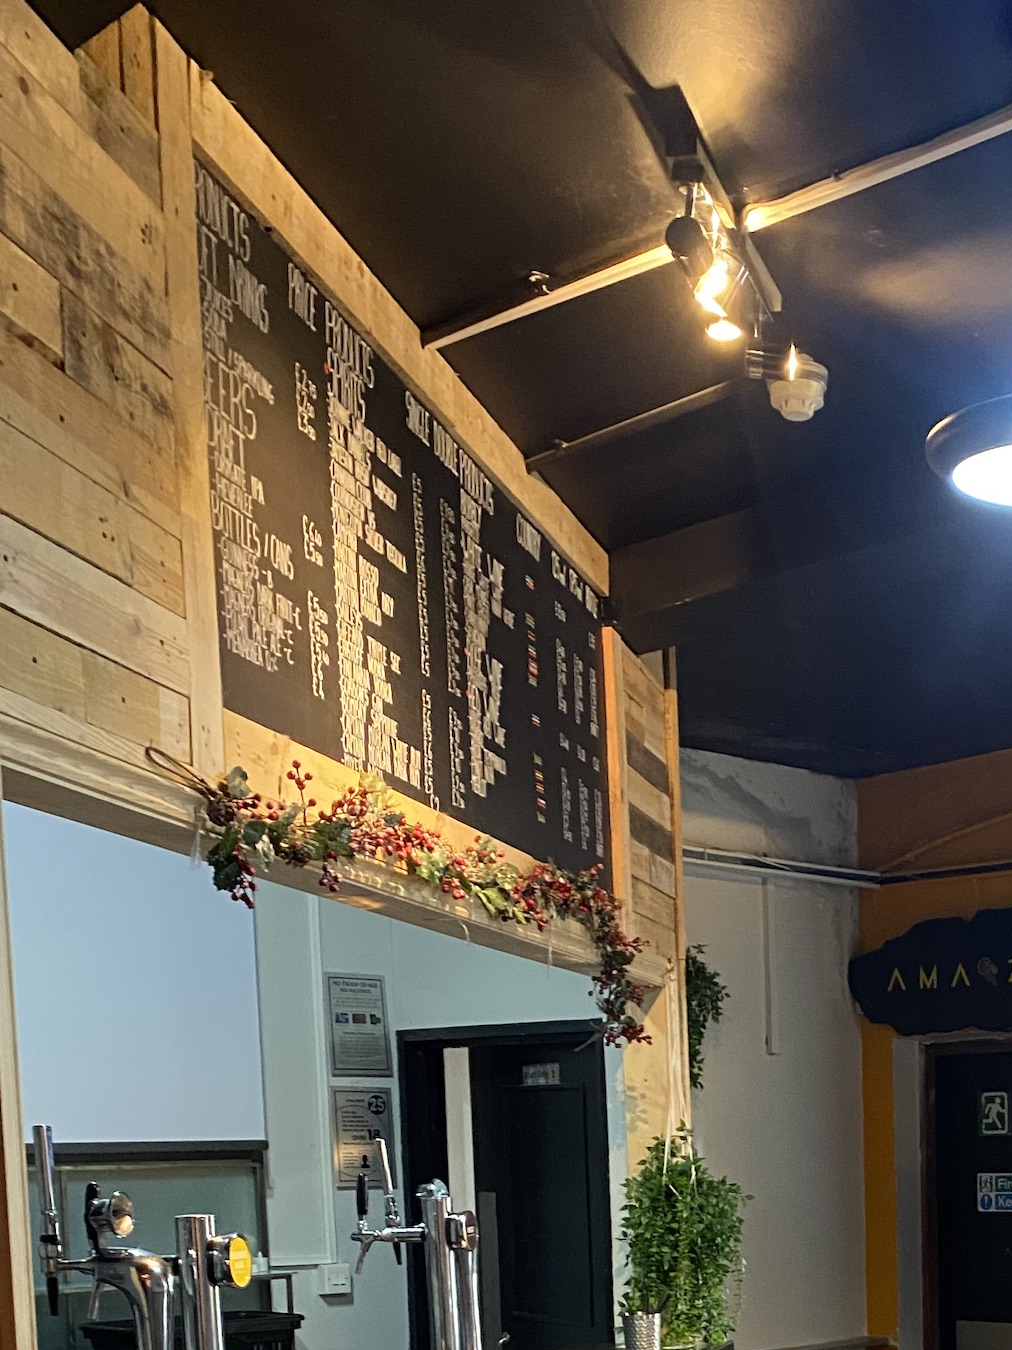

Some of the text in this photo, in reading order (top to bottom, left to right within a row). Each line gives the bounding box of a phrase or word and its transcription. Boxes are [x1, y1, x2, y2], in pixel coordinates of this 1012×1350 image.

[229, 253, 268, 333] DRINKS
[288, 262, 318, 332] PRICE
[206, 353, 256, 440] EERS
[325, 301, 374, 388] PRODUCTS
[405, 391, 429, 445] SINGLE
[433, 422, 458, 474] DOUBLE
[326, 347, 365, 422] SPIRITS
[212, 496, 259, 553] BOTTLES
[270, 534, 293, 578] CANS
[459, 451, 493, 514] PRODUCTS
[517, 511, 540, 562] COUNTRY
[369, 1098, 385, 1112] 25
